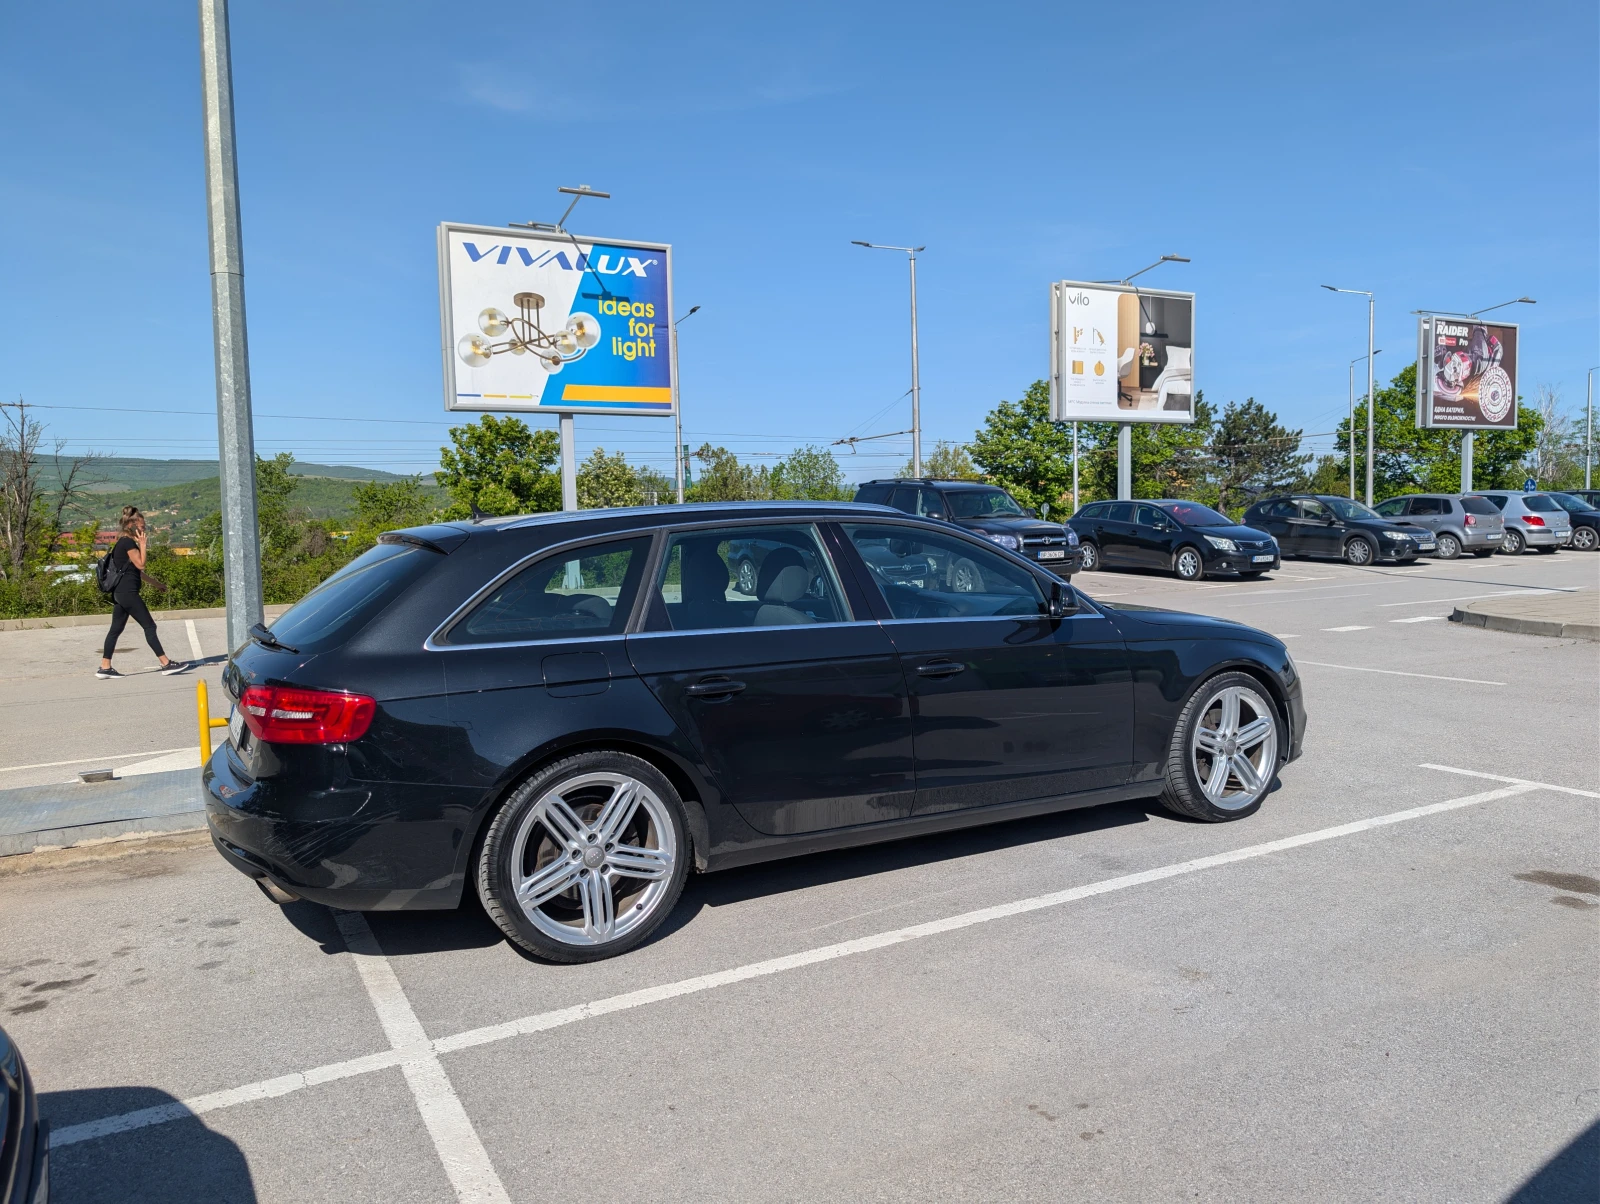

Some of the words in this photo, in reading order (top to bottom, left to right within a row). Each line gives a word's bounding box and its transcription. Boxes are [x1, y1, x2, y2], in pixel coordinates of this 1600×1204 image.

[598, 296, 655, 318] ideas
[1069, 292, 1090, 306] vilo
[628, 318, 655, 337] for
[1436, 324, 1469, 337] RAIDER
[612, 337, 656, 361] light
[1458, 338, 1469, 346] Pro
